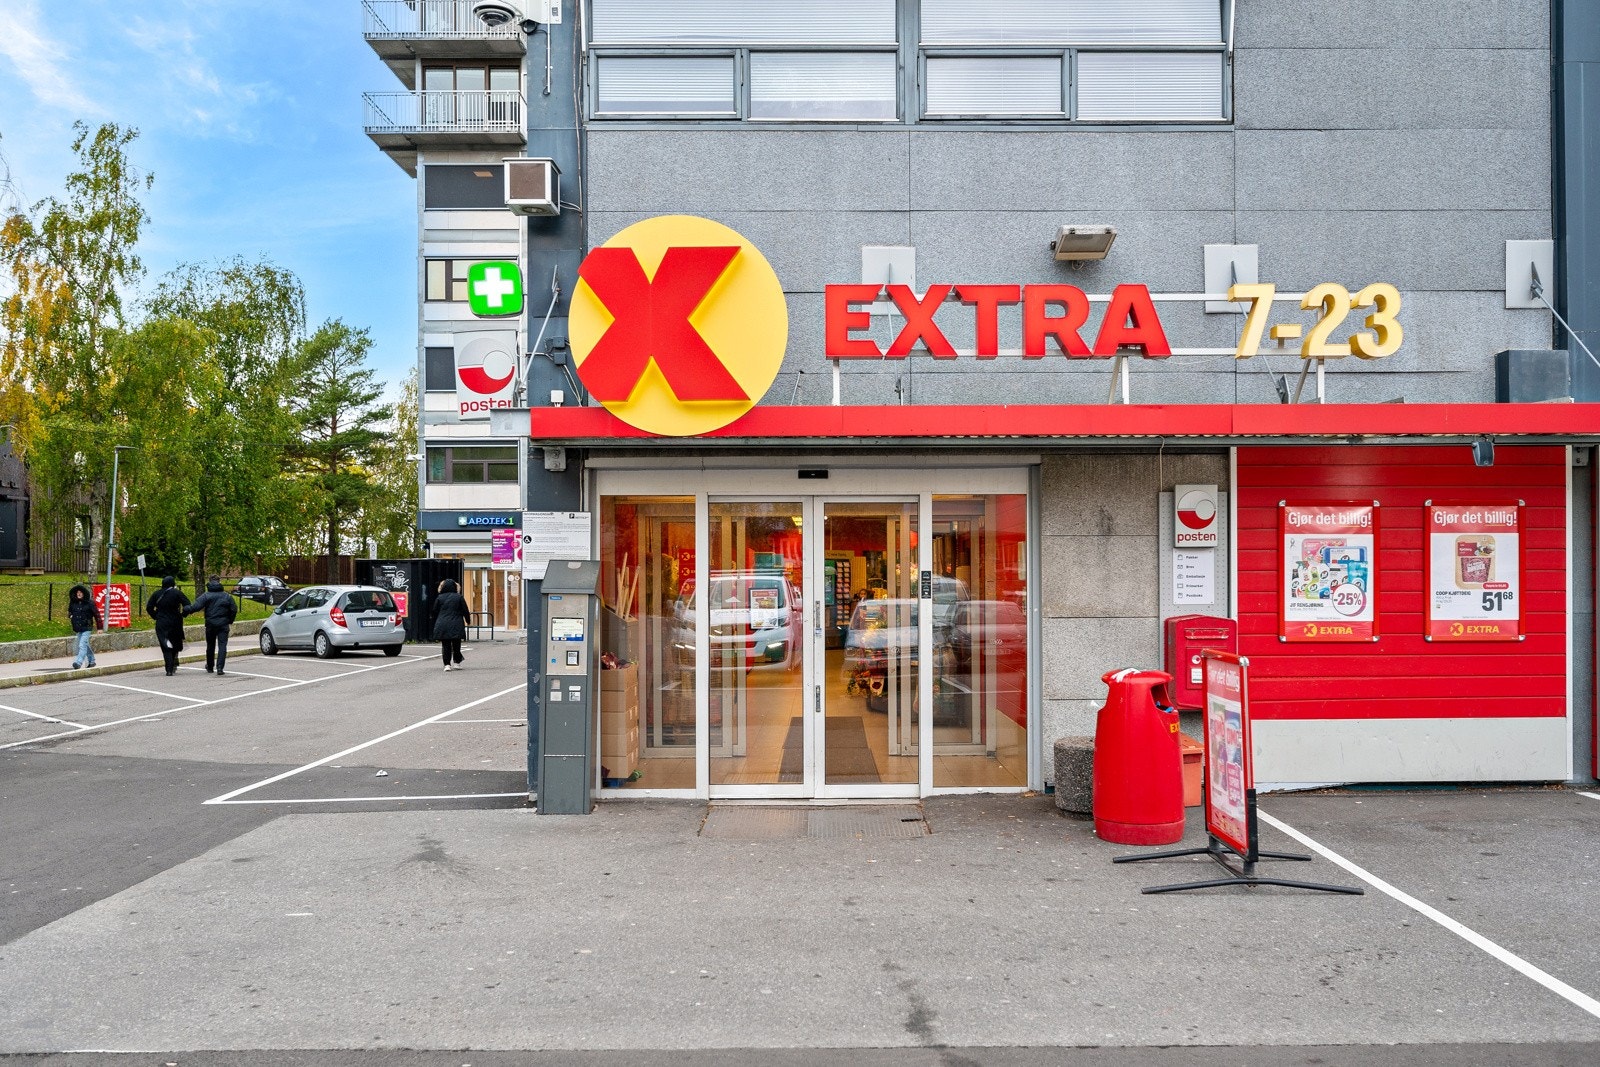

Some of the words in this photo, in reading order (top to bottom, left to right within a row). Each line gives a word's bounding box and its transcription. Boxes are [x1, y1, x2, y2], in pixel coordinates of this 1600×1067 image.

[825, 283, 1172, 360] EXTRA
[1227, 282, 1403, 360] 7-23
[468, 517, 507, 525] APOTEK
[1288, 512, 1313, 527] Gjør
[1316, 512, 1336, 525] det
[1339, 512, 1371, 528] billig!
[1434, 511, 1459, 526] Gjør
[1462, 511, 1482, 524] det
[1485, 511, 1517, 526] billig!
[1177, 532, 1216, 543] posten
[1333, 592, 1362, 606] -25%
[1320, 626, 1353, 635] EXTRA
[1466, 625, 1500, 634] EXTRA
